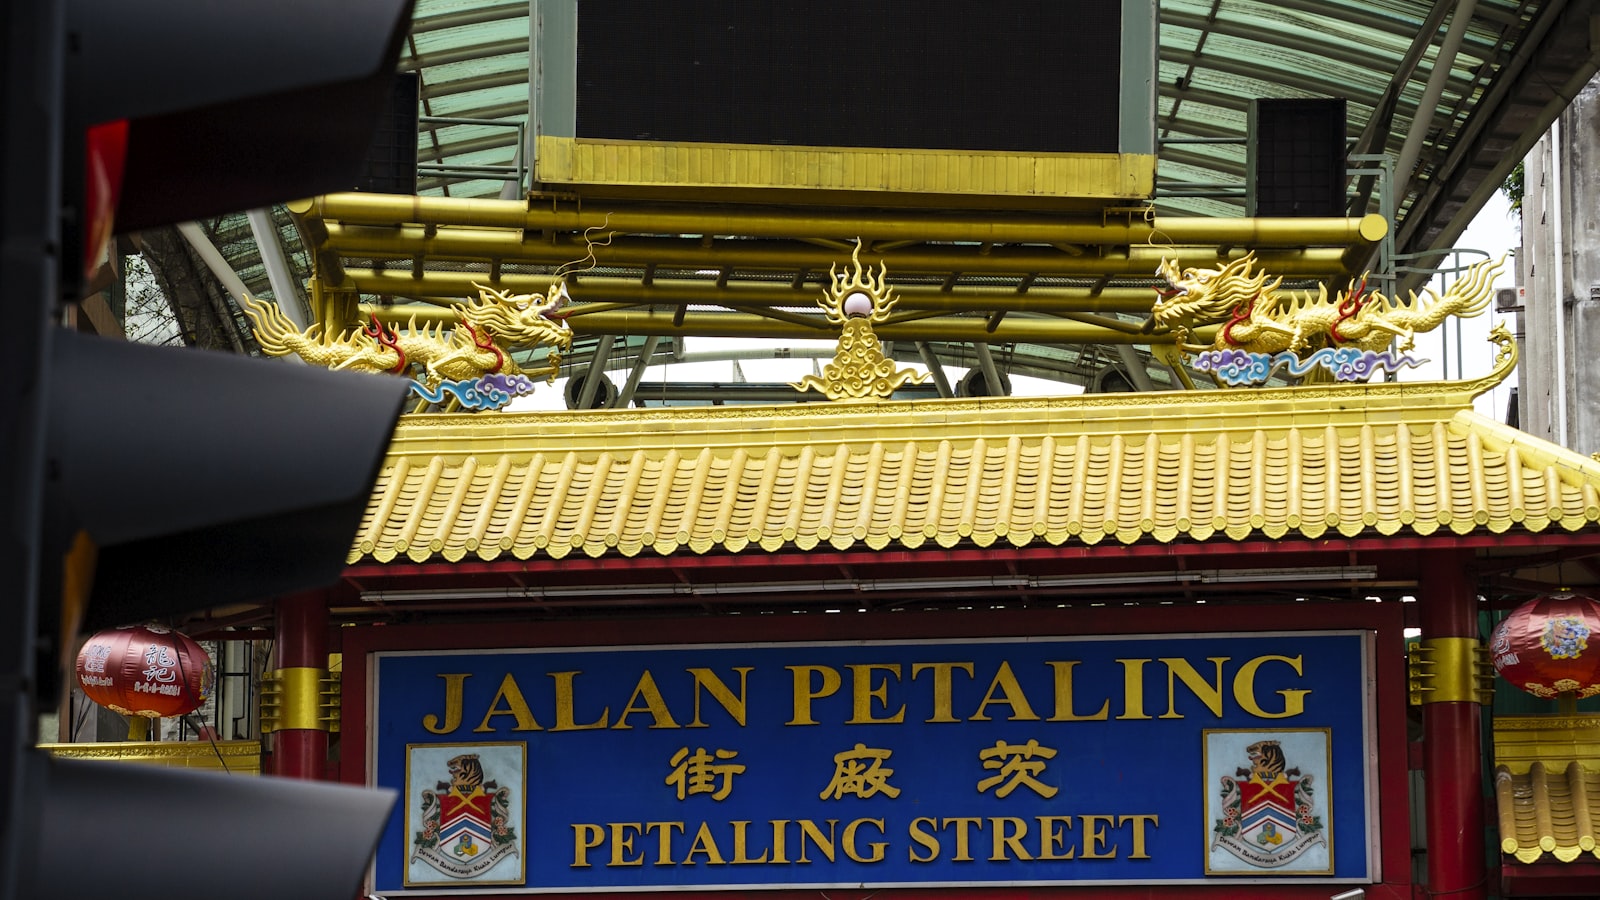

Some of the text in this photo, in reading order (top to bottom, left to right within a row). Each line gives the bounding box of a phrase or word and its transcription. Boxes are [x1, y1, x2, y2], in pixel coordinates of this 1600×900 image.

[422, 654, 1312, 734] JALAN PETALING
[418, 844, 513, 875] Dewan Bandaraya Kuala Lumpur
[570, 814, 1159, 868] PETALING STREET
[1219, 833, 1319, 864] Dewan Bandaraya Kuala Lumpur
